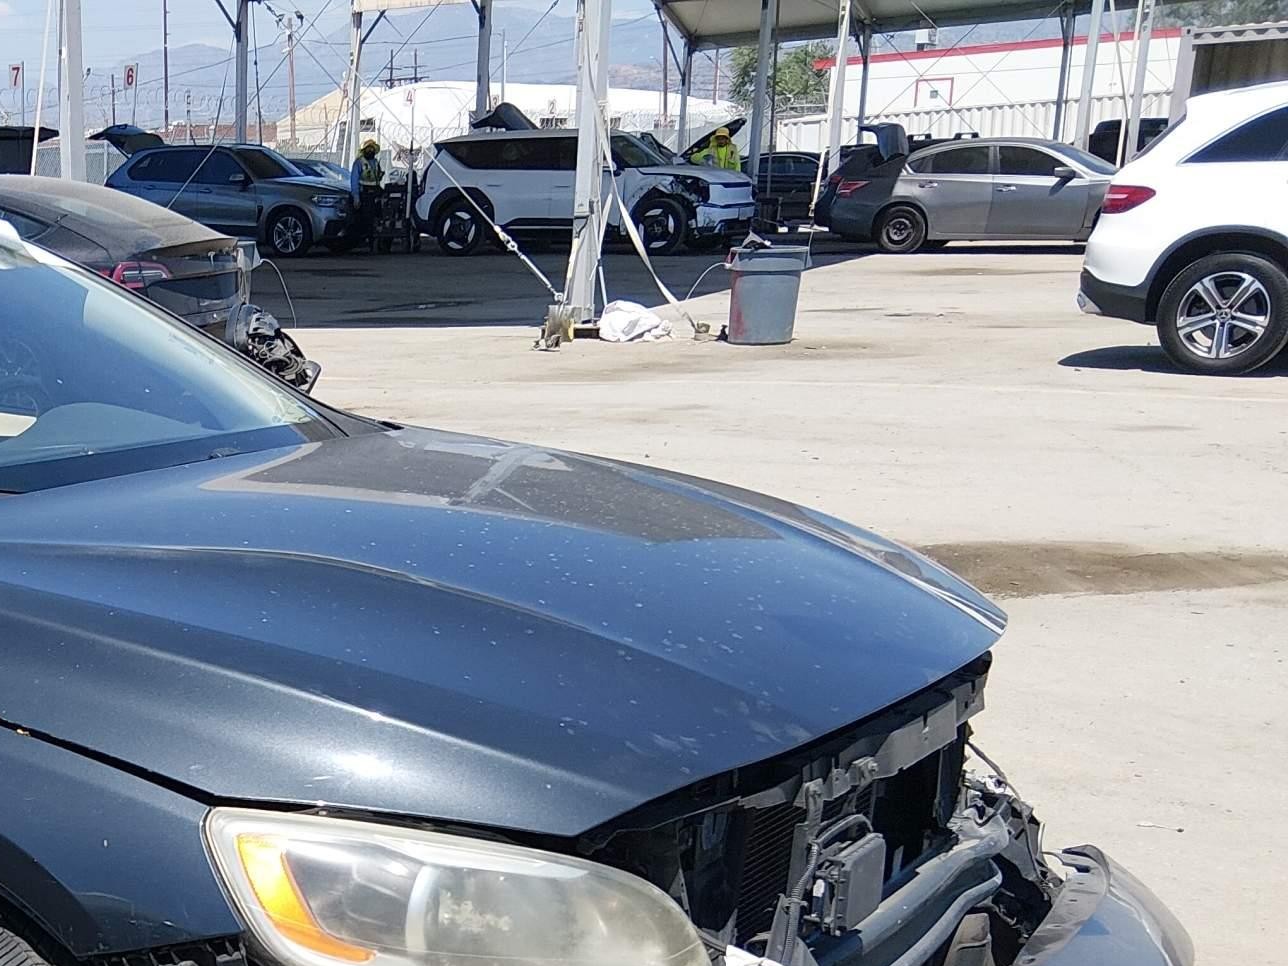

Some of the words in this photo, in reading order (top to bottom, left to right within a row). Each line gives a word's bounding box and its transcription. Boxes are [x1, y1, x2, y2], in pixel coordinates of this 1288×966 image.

[11, 66, 21, 87] 7
[125, 67, 134, 86] 6
[405, 89, 413, 105] 4
[548, 101, 555, 115] 2
